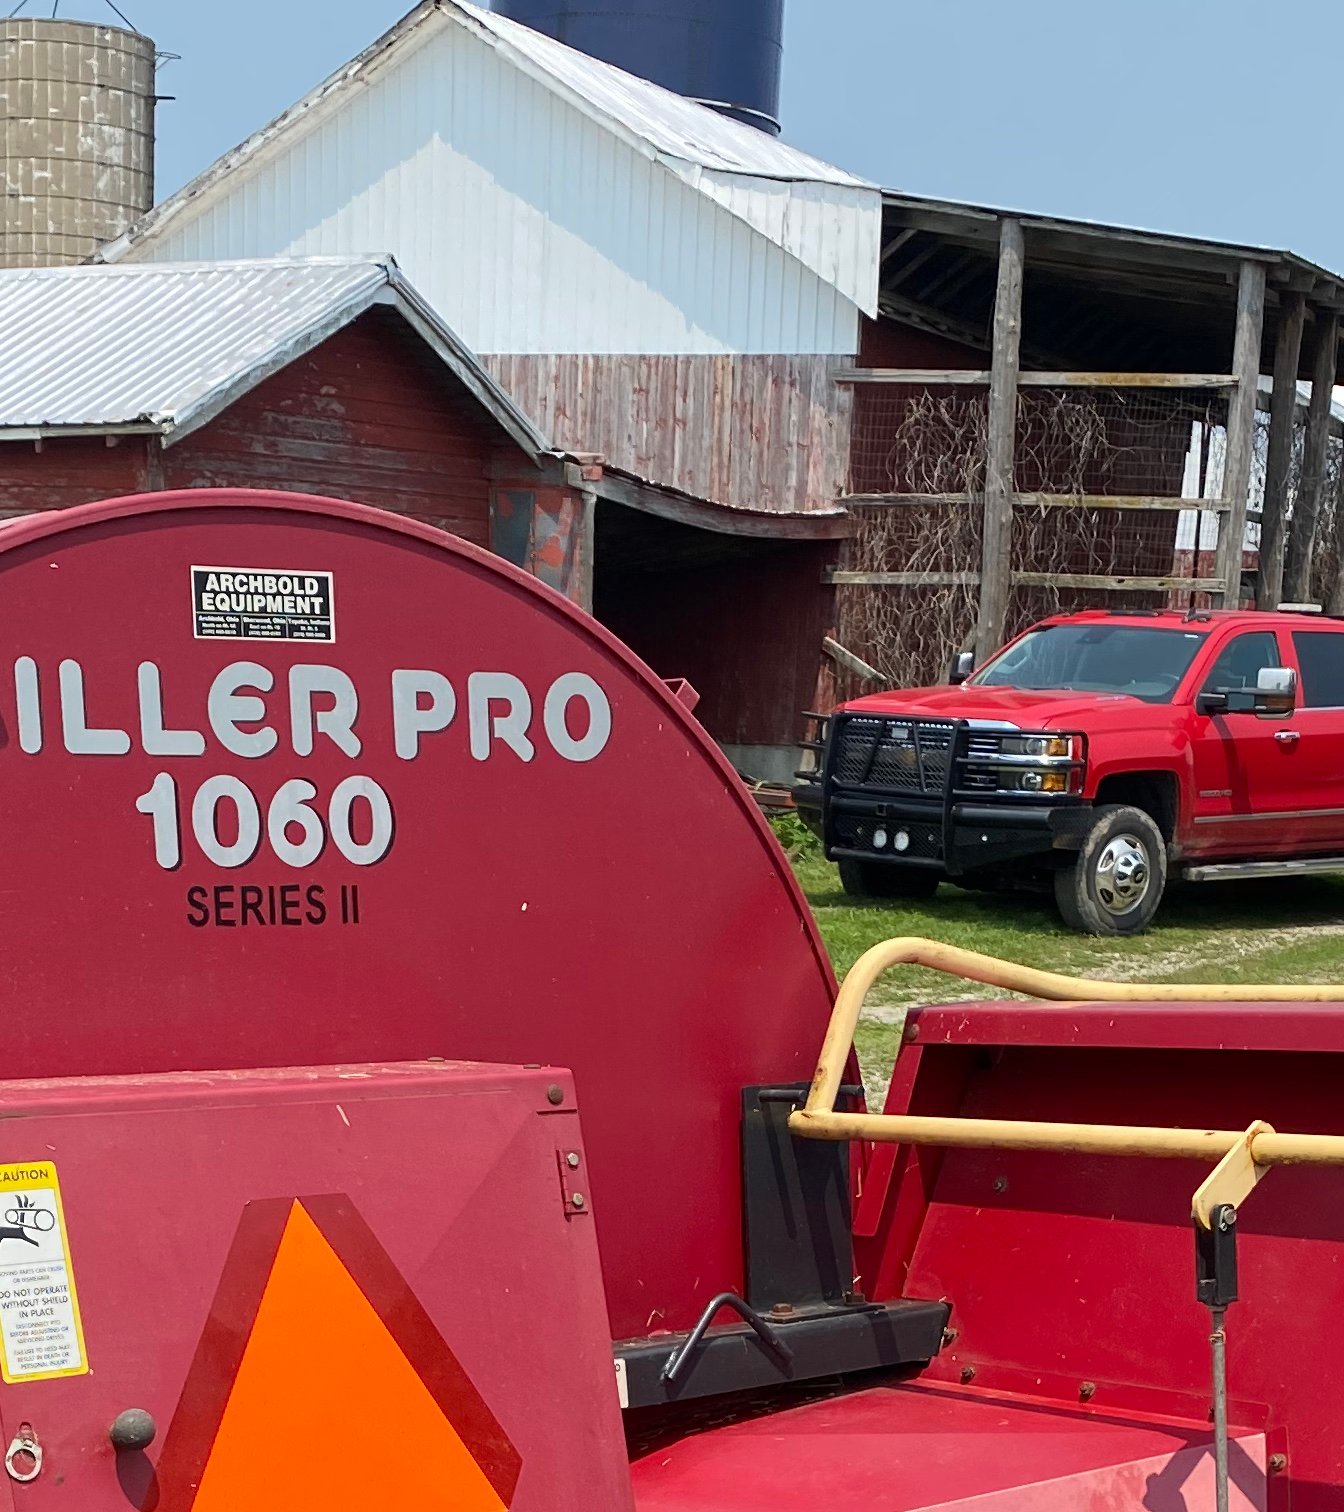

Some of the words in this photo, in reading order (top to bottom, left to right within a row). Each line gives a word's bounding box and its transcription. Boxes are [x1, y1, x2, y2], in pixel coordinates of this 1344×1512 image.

[205, 573, 320, 595] ARCHBOLD
[201, 592, 324, 615] EQUIPMENT
[391, 667, 614, 763] PRO
[135, 771, 395, 871] 1060
[185, 883, 328, 929] SERIES
[340, 884, 362, 925] II
[1, 1299, 39, 1309] WITHOUT
[42, 1295, 68, 1305] SHIELD
[13, 1288, 31, 1297] NOT
[33, 1285, 68, 1295] OPERATE
[19, 1310, 28, 1318] IN
[30, 1308, 54, 1317] PLACE
